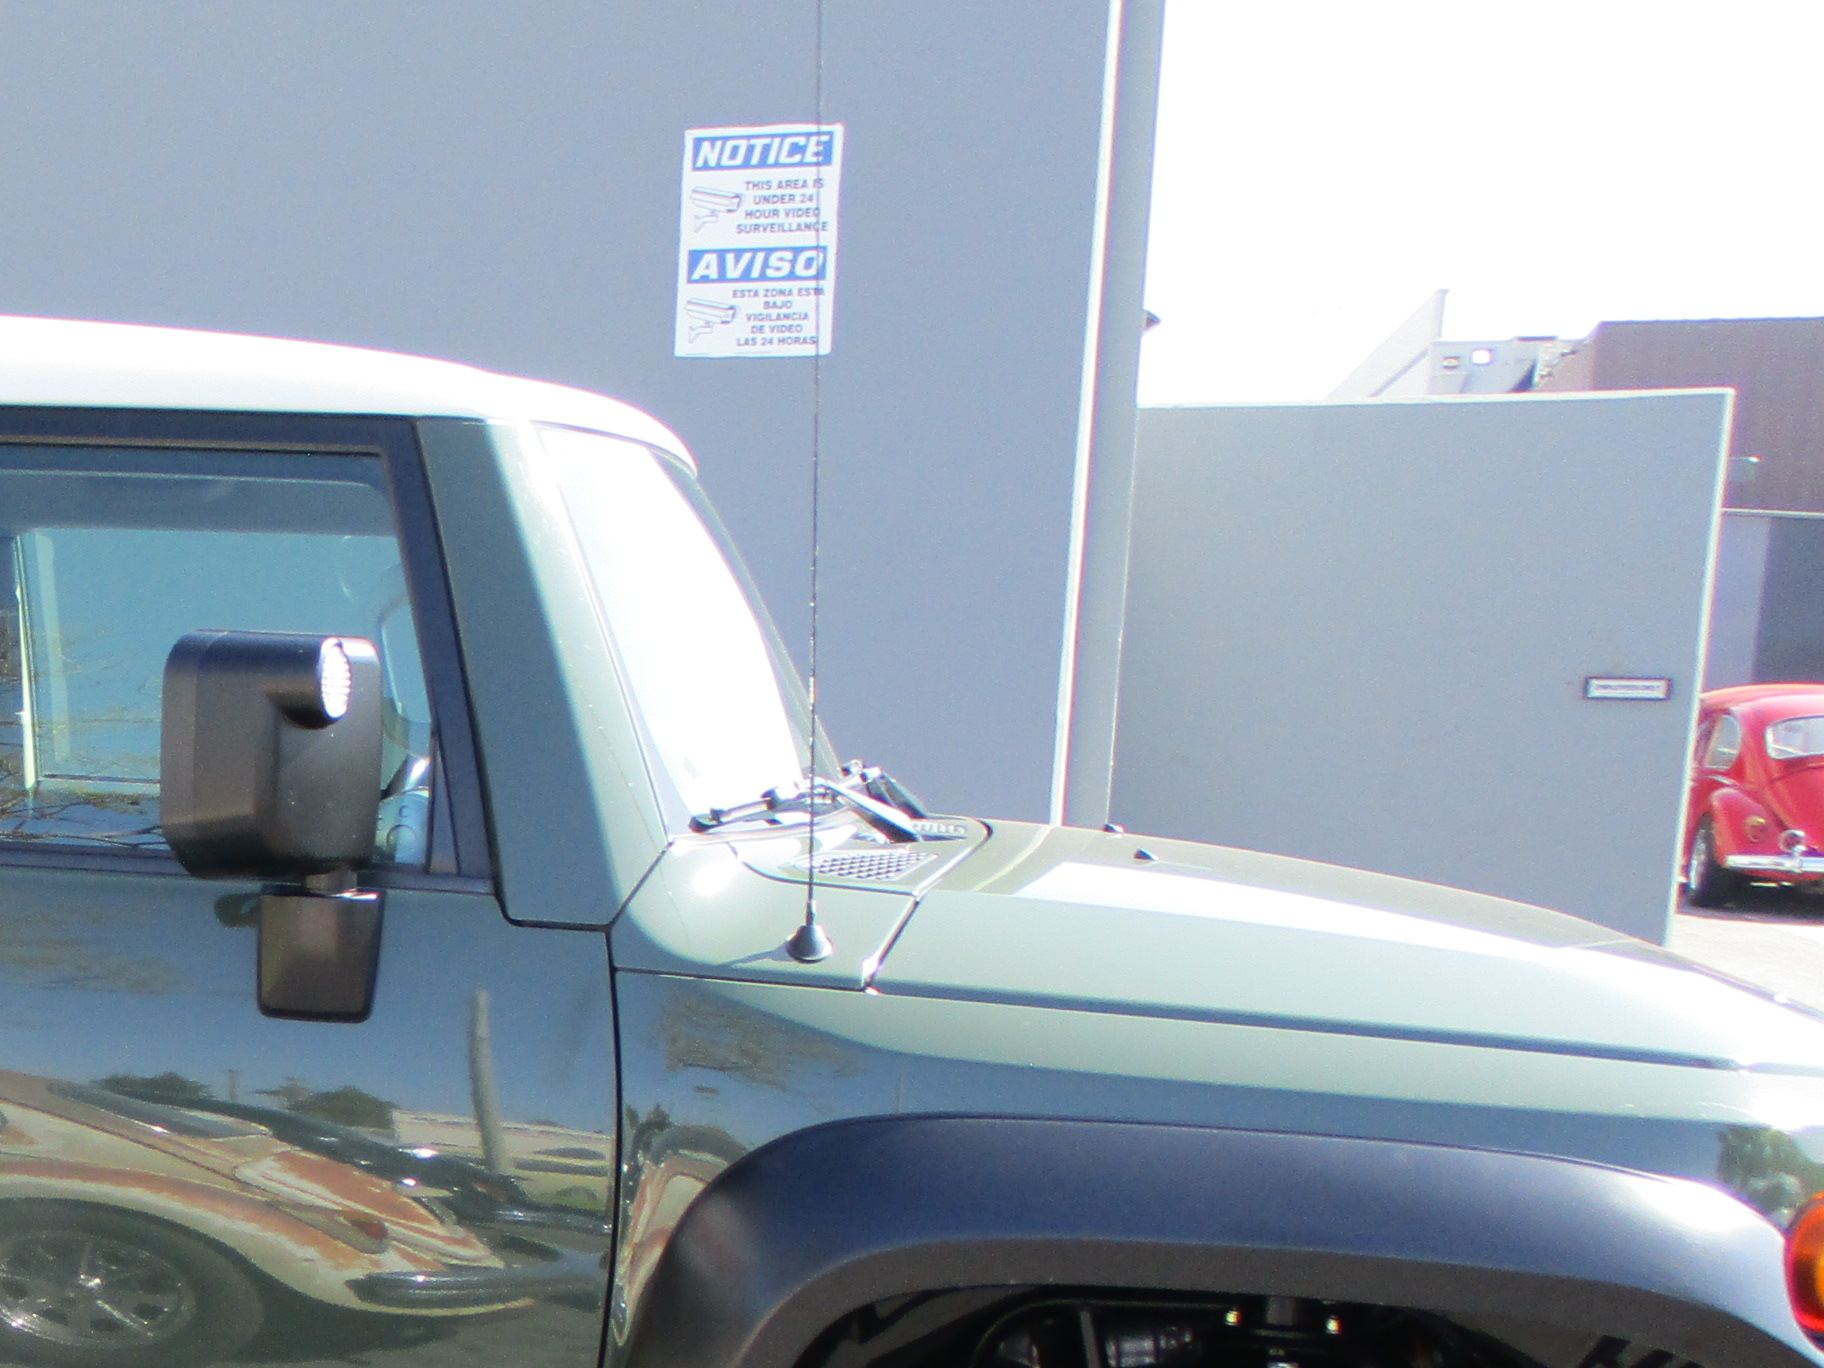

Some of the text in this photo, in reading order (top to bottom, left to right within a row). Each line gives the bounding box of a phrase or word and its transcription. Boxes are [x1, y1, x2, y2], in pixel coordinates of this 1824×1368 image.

[696, 135, 830, 167] NOTICE
[745, 179, 824, 190] THIS AREA IS
[754, 194, 814, 204] UNDER 24
[745, 208, 820, 219] HOUR VIDEO
[736, 222, 829, 234] SURVEILLANCE
[691, 252, 824, 280] AVISO
[732, 290, 758, 298] ESTA
[763, 289, 792, 297] ZONA
[763, 301, 792, 309] BAJO
[746, 313, 809, 321] VIGILANCIA
[751, 325, 802, 334] DE VIDEO
[737, 336, 816, 346] LAS 24 HORAS
